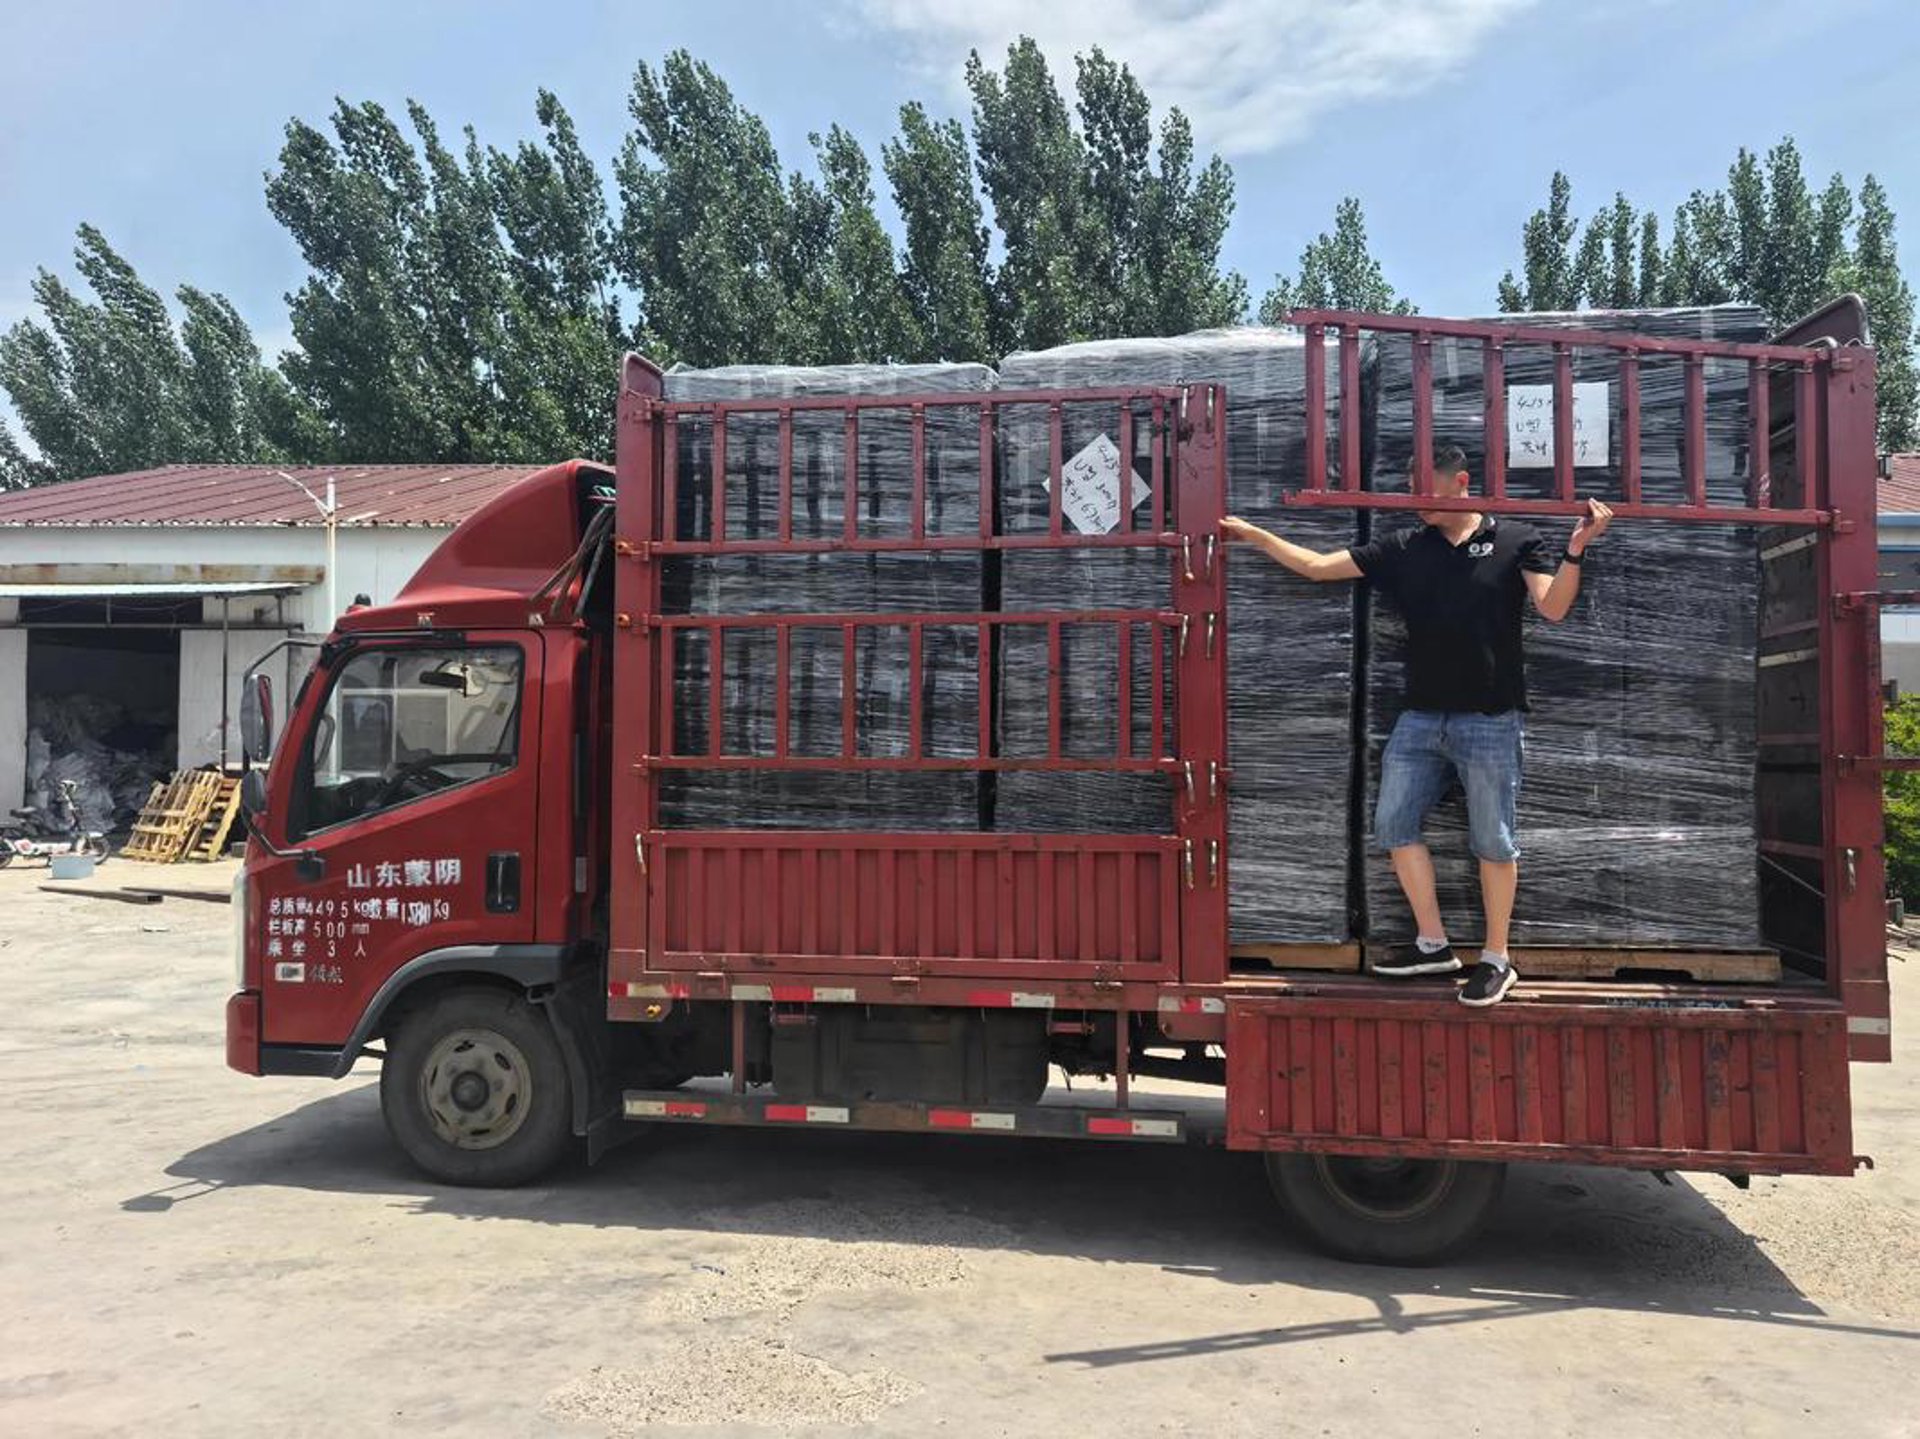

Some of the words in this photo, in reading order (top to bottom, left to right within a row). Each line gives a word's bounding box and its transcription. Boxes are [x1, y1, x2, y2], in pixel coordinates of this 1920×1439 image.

[347, 858, 461, 887] 山东蒙阴
[313, 920, 345, 938] 500
[328, 940, 336, 958] 3
[354, 939, 366, 957] 人
